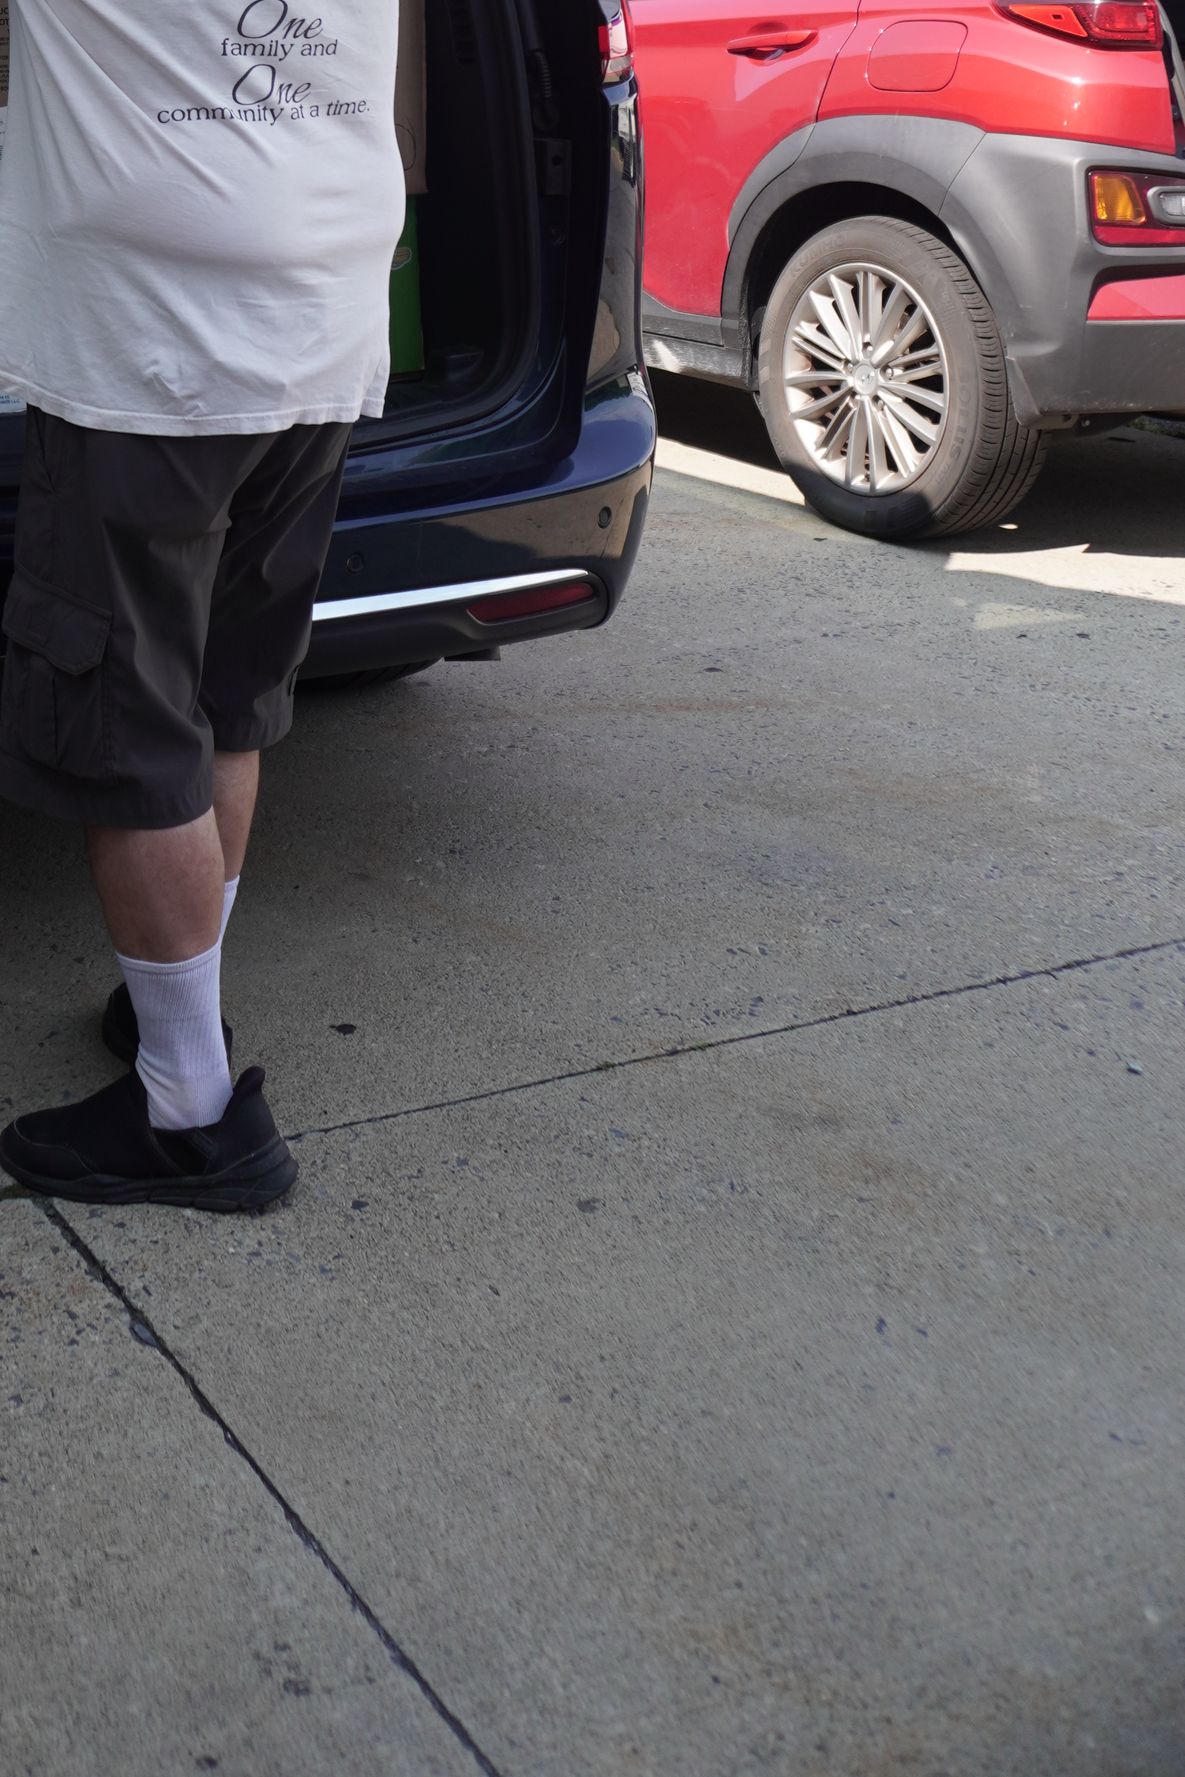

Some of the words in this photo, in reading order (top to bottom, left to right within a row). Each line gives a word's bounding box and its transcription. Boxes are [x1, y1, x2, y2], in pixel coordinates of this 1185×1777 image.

[220, 38, 294, 61] family
[300, 39, 338, 57] and
[232, 63, 312, 106] One
[157, 104, 285, 126] community
[290, 105, 304, 120] at
[309, 106, 320, 118] a
[326, 98, 370, 117] time.
